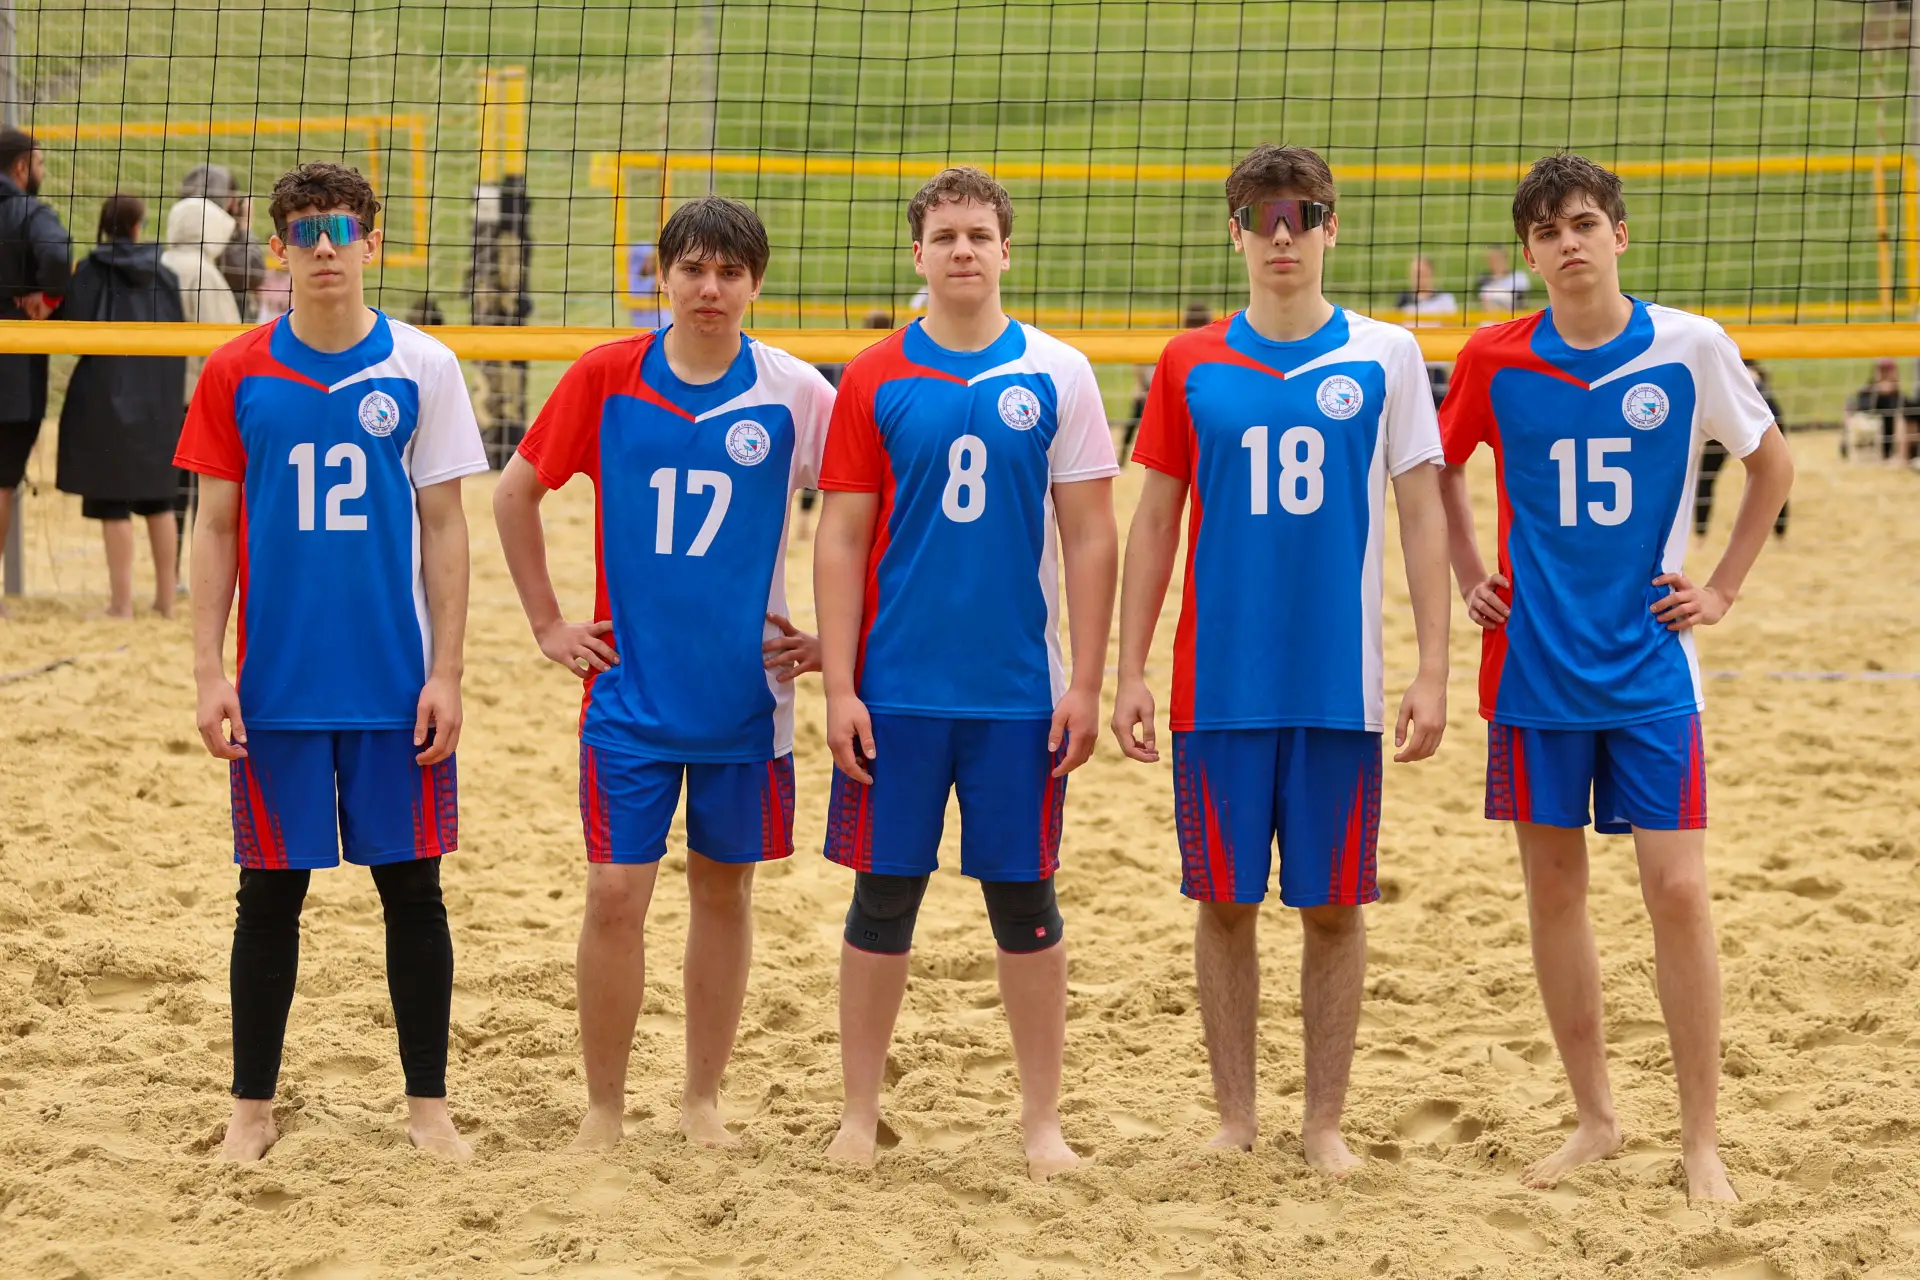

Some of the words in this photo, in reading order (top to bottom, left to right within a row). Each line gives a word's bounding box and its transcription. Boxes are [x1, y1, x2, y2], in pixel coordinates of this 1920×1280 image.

[289, 443, 368, 530] 12
[650, 467, 733, 556] 17
[942, 434, 988, 522] 8
[1241, 426, 1325, 515] 18
[1549, 438, 1633, 526] 15
